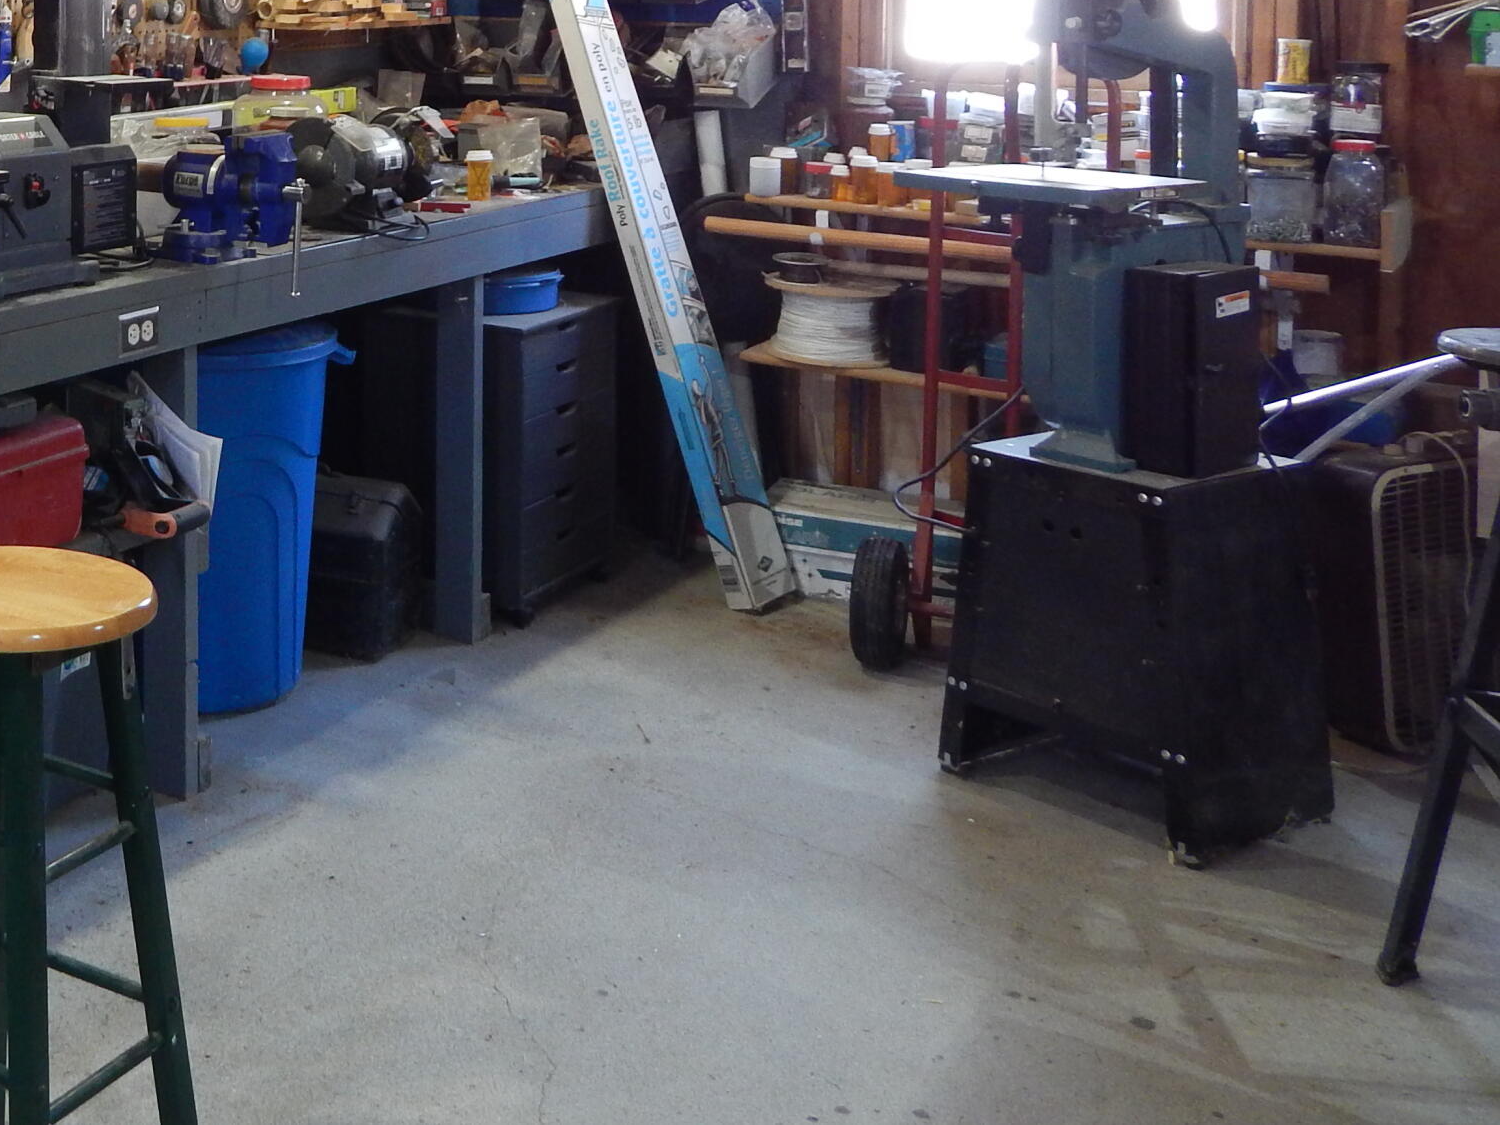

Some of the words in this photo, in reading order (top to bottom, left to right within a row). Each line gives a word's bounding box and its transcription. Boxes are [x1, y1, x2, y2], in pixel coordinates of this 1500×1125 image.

[591, 41, 609, 74] poly
[601, 75, 613, 93] en
[588, 118, 609, 159] Rake
[607, 100, 651, 220] couverture
[599, 163, 622, 203] Roof
[616, 204, 629, 227] Poly
[651, 246, 678, 318] Gratte
